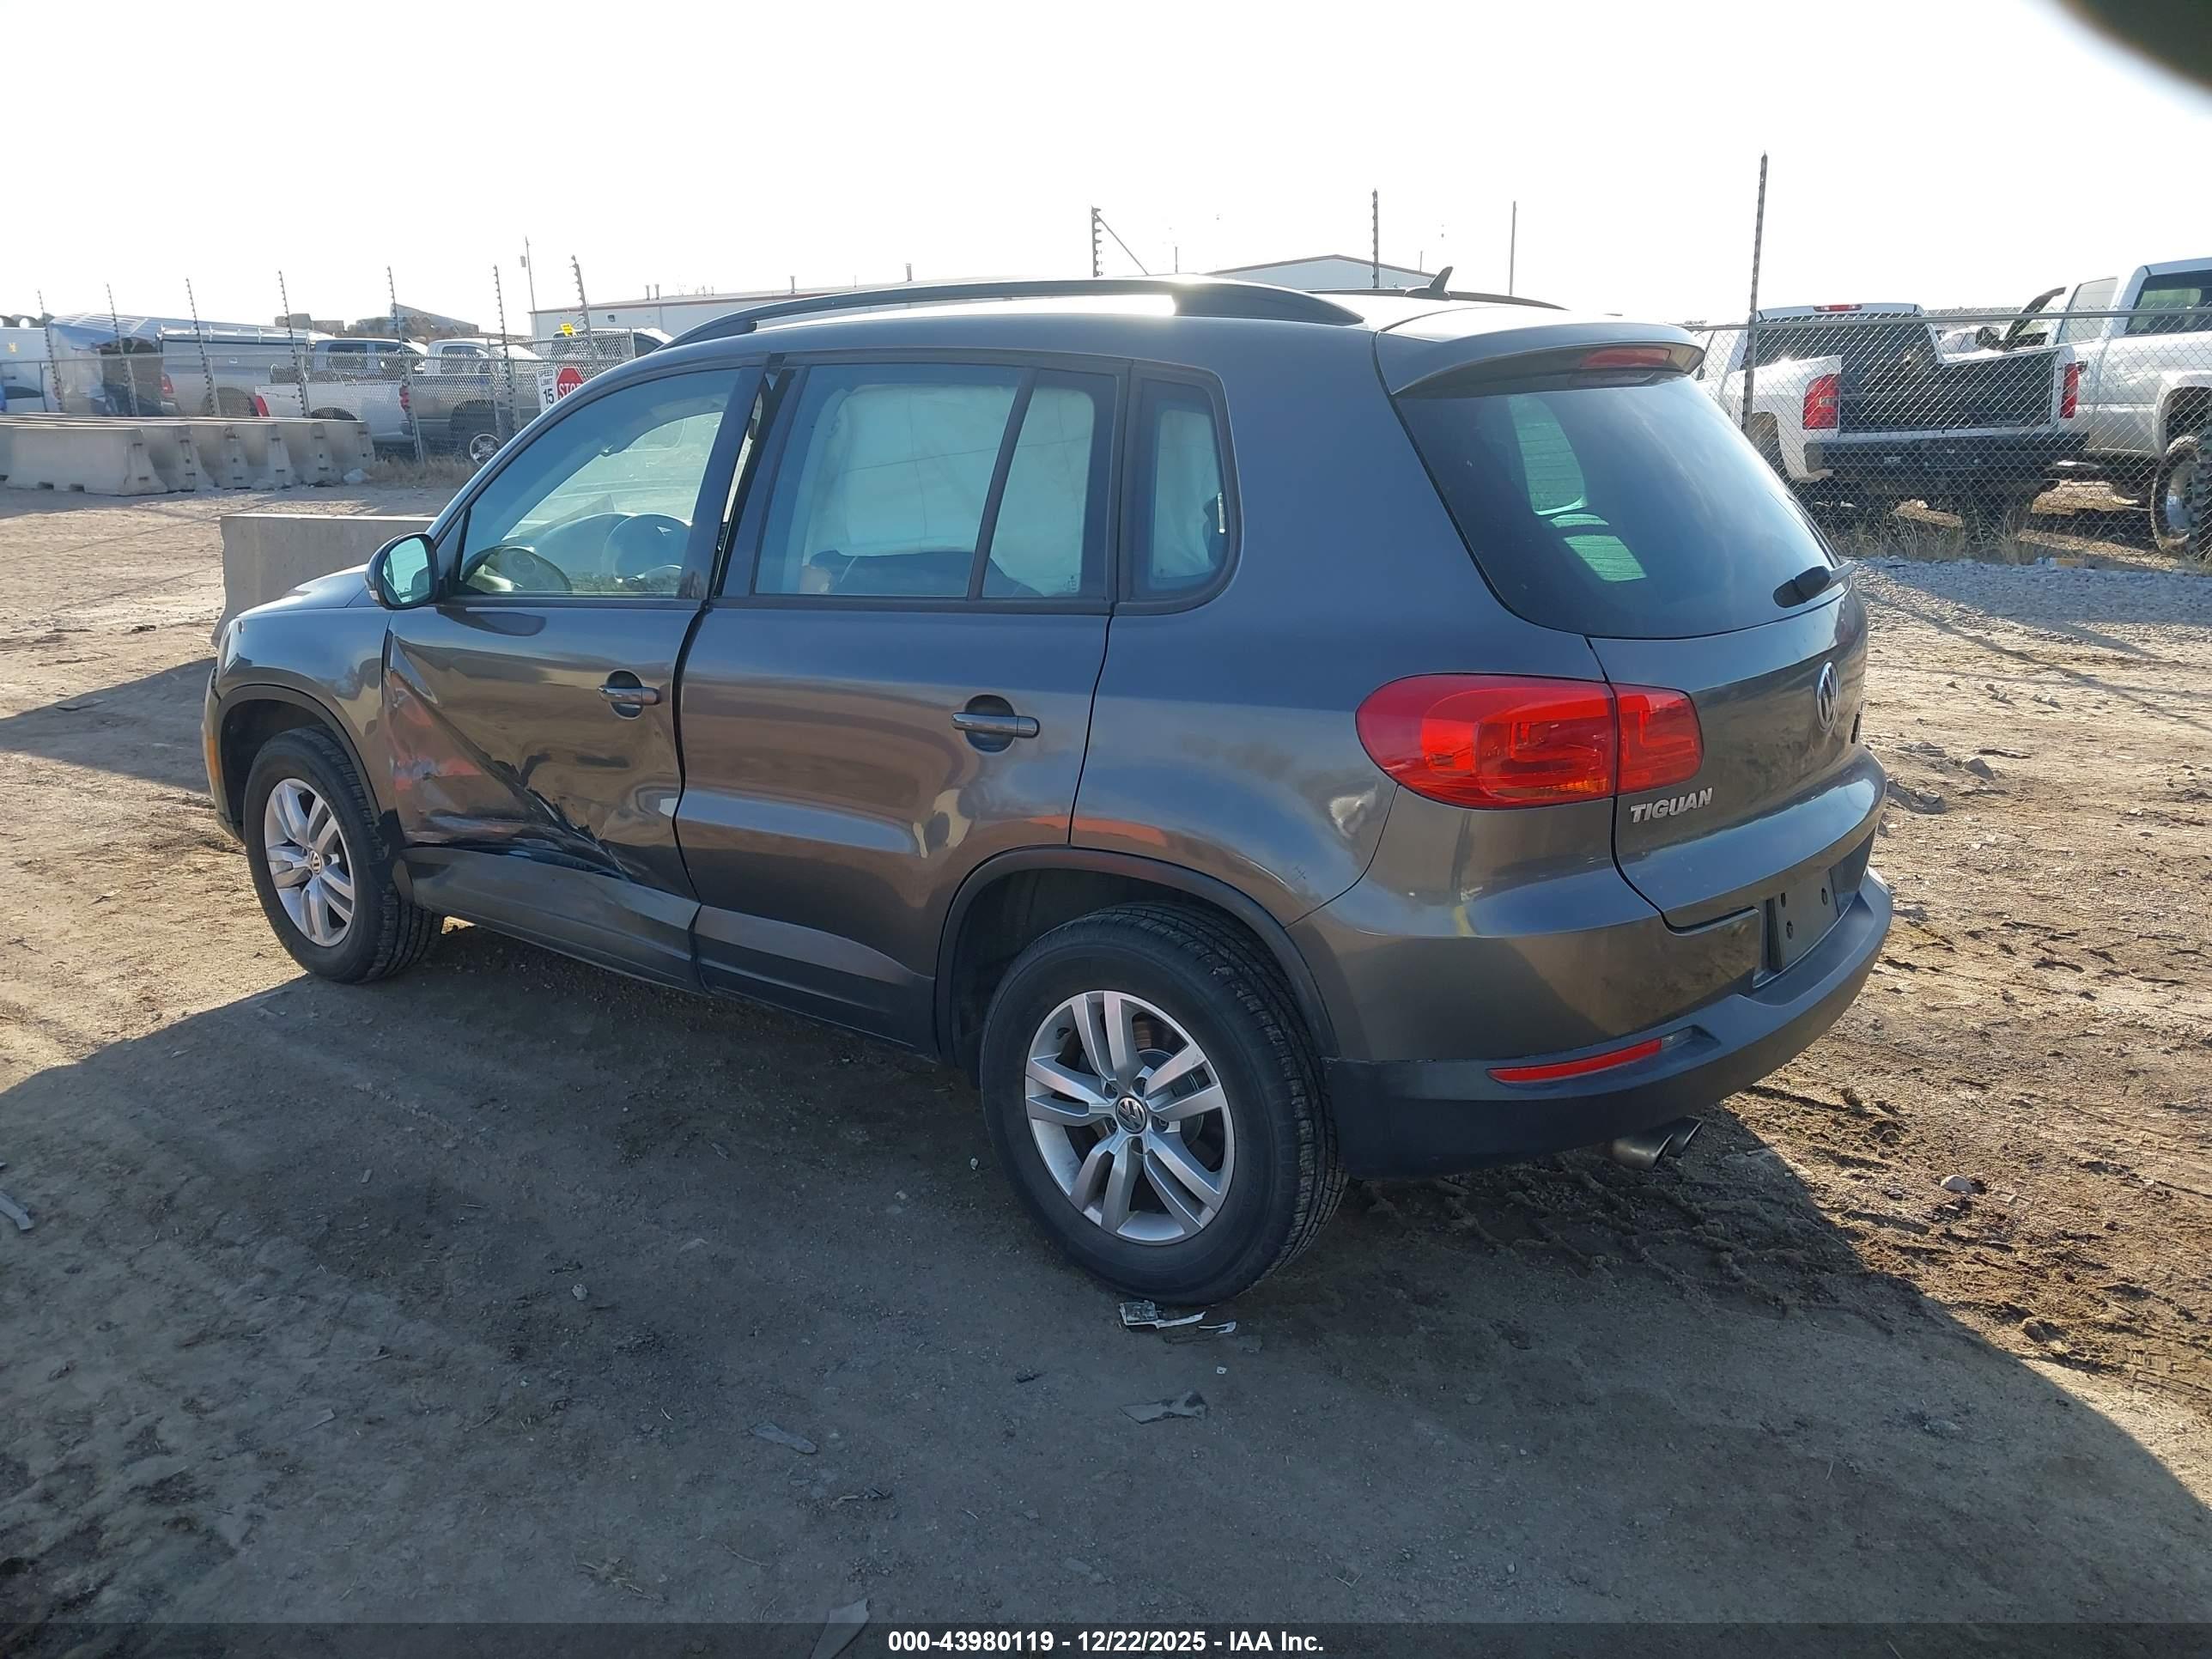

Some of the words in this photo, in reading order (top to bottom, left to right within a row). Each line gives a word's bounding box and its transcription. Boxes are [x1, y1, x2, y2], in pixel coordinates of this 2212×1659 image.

[538, 369, 553, 378] SPEED
[541, 378, 553, 386] LIMIT
[543, 388, 555, 404] 15
[1630, 787, 1713, 823] TIGUAN
